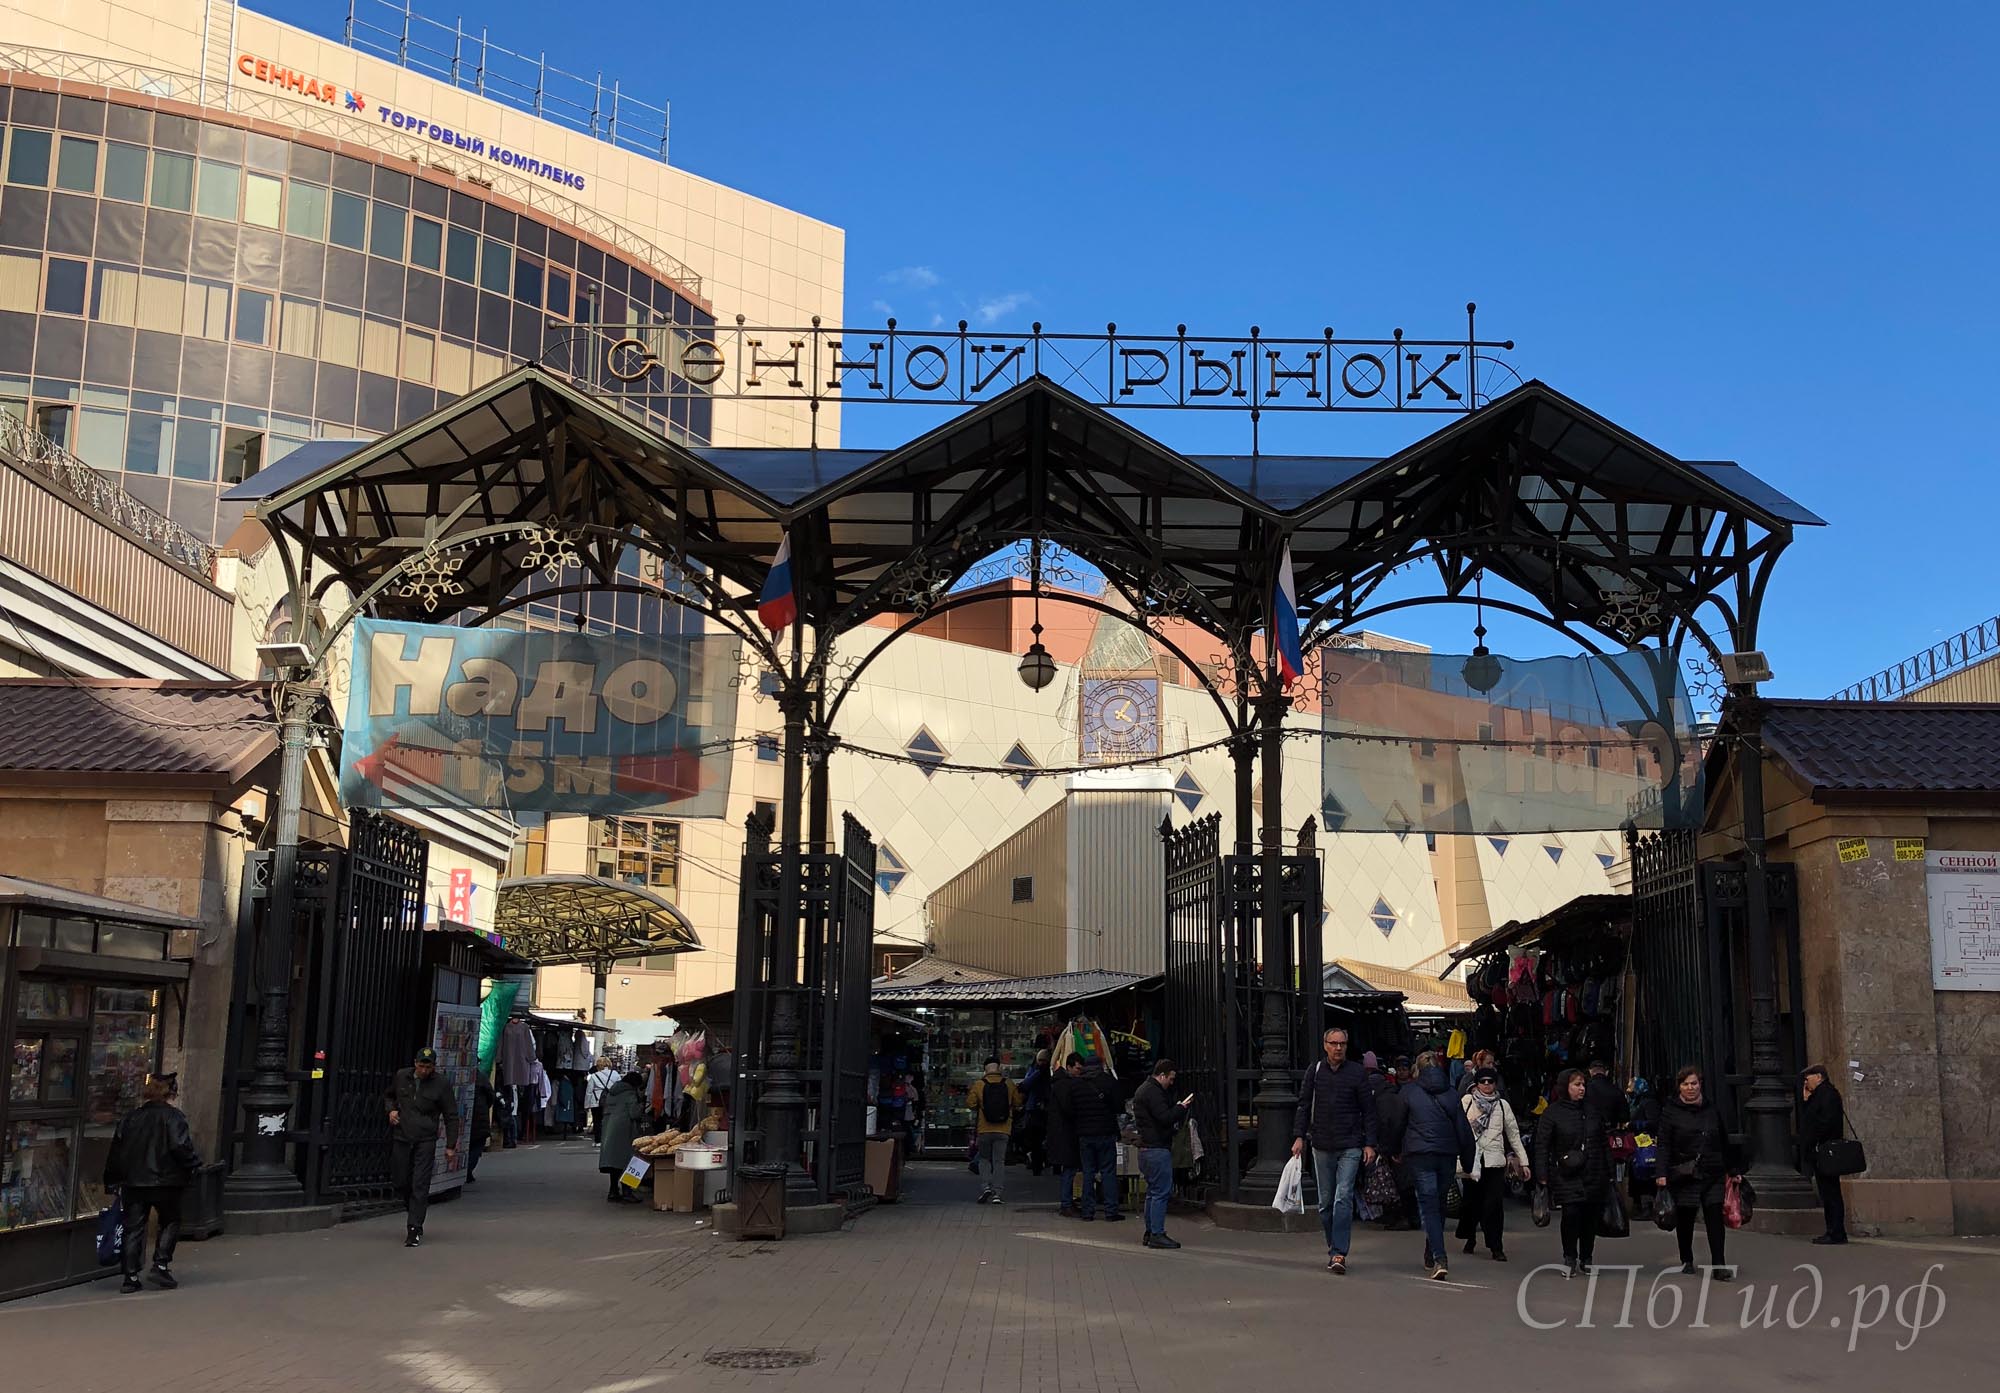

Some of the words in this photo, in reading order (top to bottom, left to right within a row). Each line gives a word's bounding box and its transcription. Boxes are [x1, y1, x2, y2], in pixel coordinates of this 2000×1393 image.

[237, 54, 337, 105] СЕННАЯ
[378, 106, 485, 157] ТОРГОВЫЙ
[488, 146, 586, 191] КОМПЛЕКС
[1119, 348, 1462, 400] РЫНОК
[368, 631, 721, 734] Надо!
[458, 738, 545, 794] 15
[1939, 854, 1997, 867] СЕННОЙ
